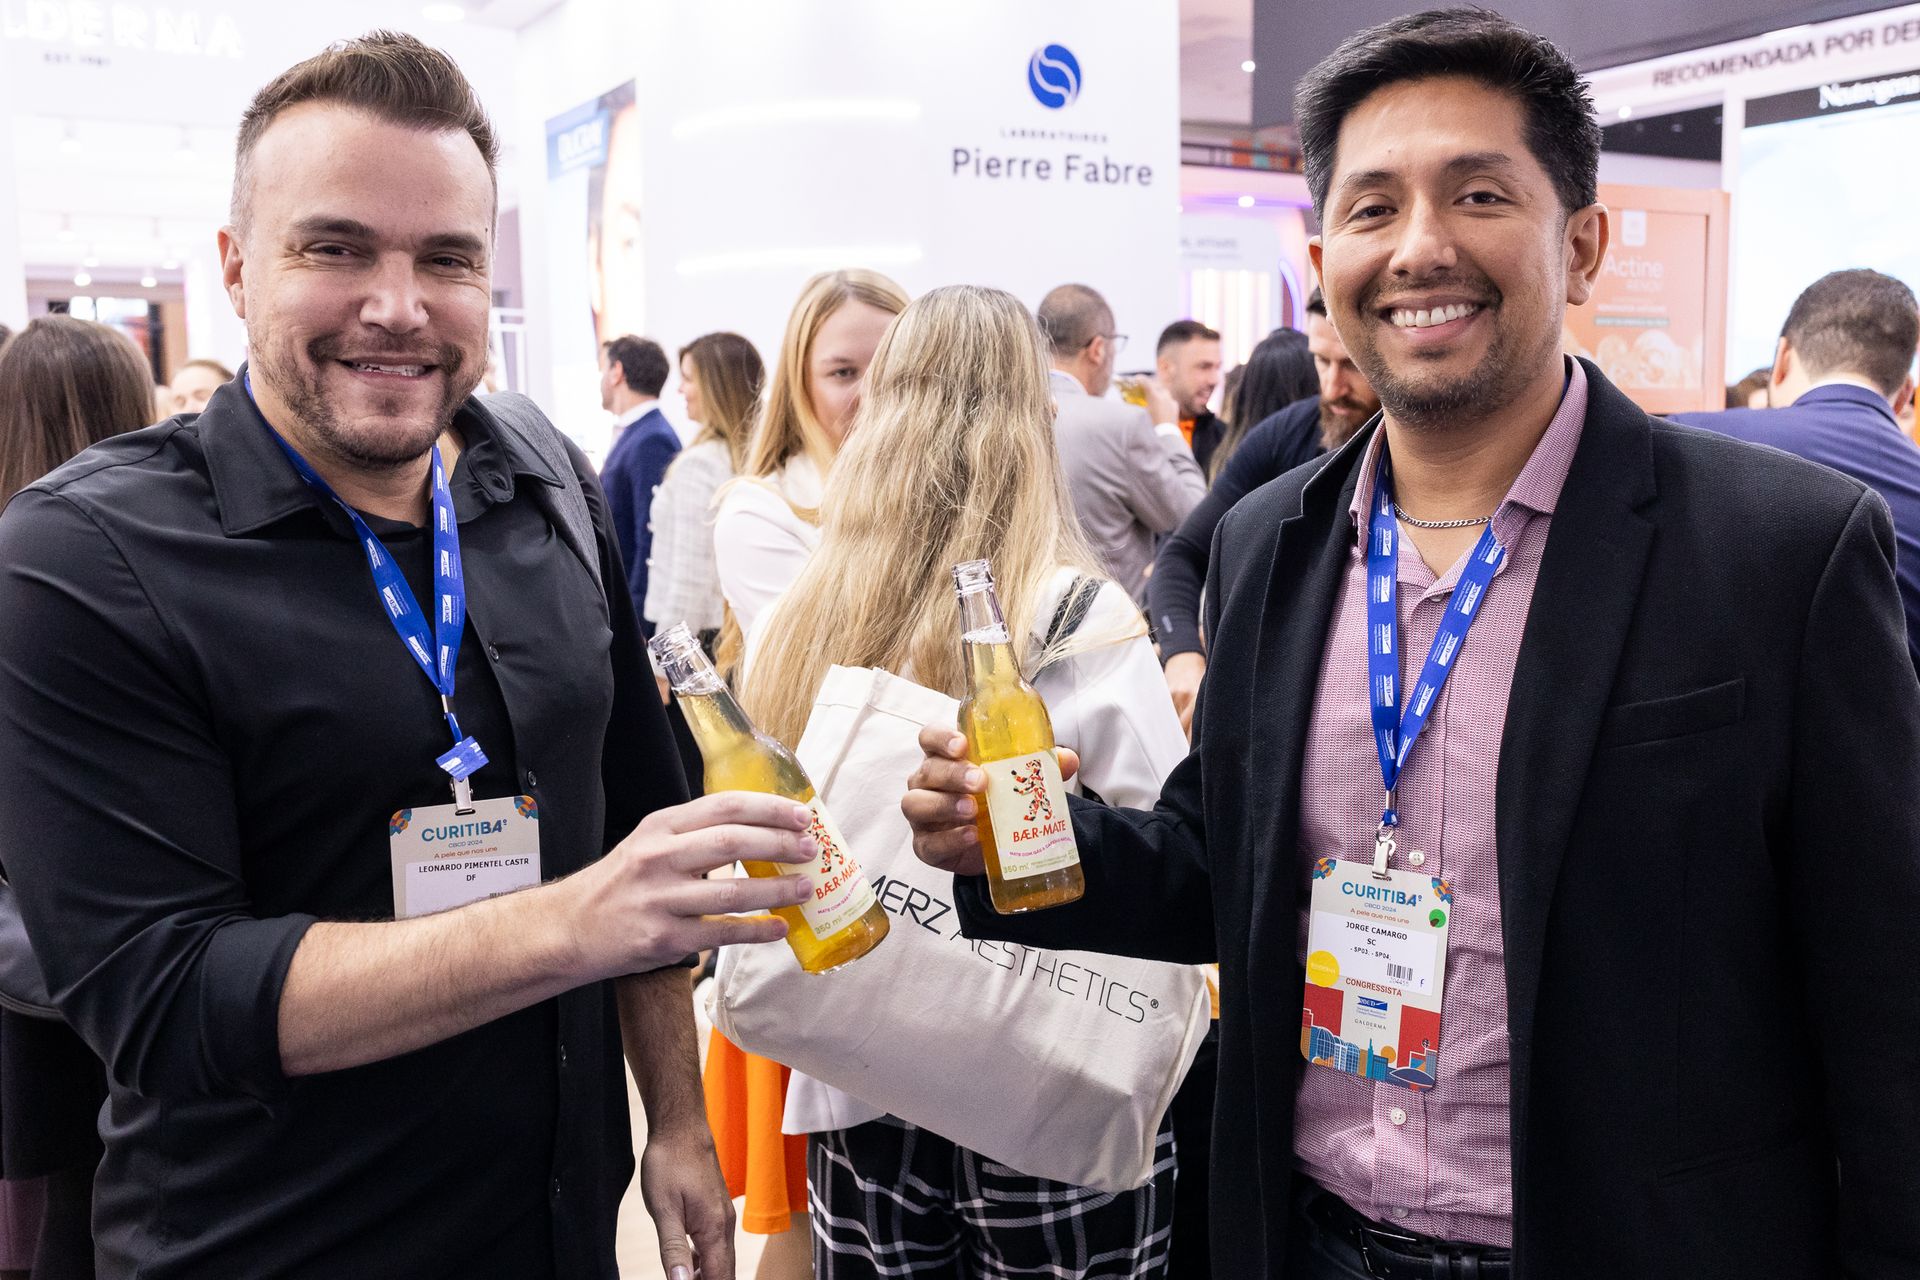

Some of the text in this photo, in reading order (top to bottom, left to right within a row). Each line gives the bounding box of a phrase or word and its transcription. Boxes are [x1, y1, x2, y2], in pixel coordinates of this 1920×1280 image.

[1652, 20, 1920, 87] RECOMENDADA POR DE
[952, 148, 1153, 186] Pierre Fabre
[1604, 254, 1664, 278] Actine
[418, 858, 529, 872] LEONARDO PIMENTEL CASTR
[1346, 922, 1407, 940] JORGE CAMARGO
[1345, 978, 1402, 996] CONGRESSISTA
[1354, 1019, 1386, 1030] GALDERMA
